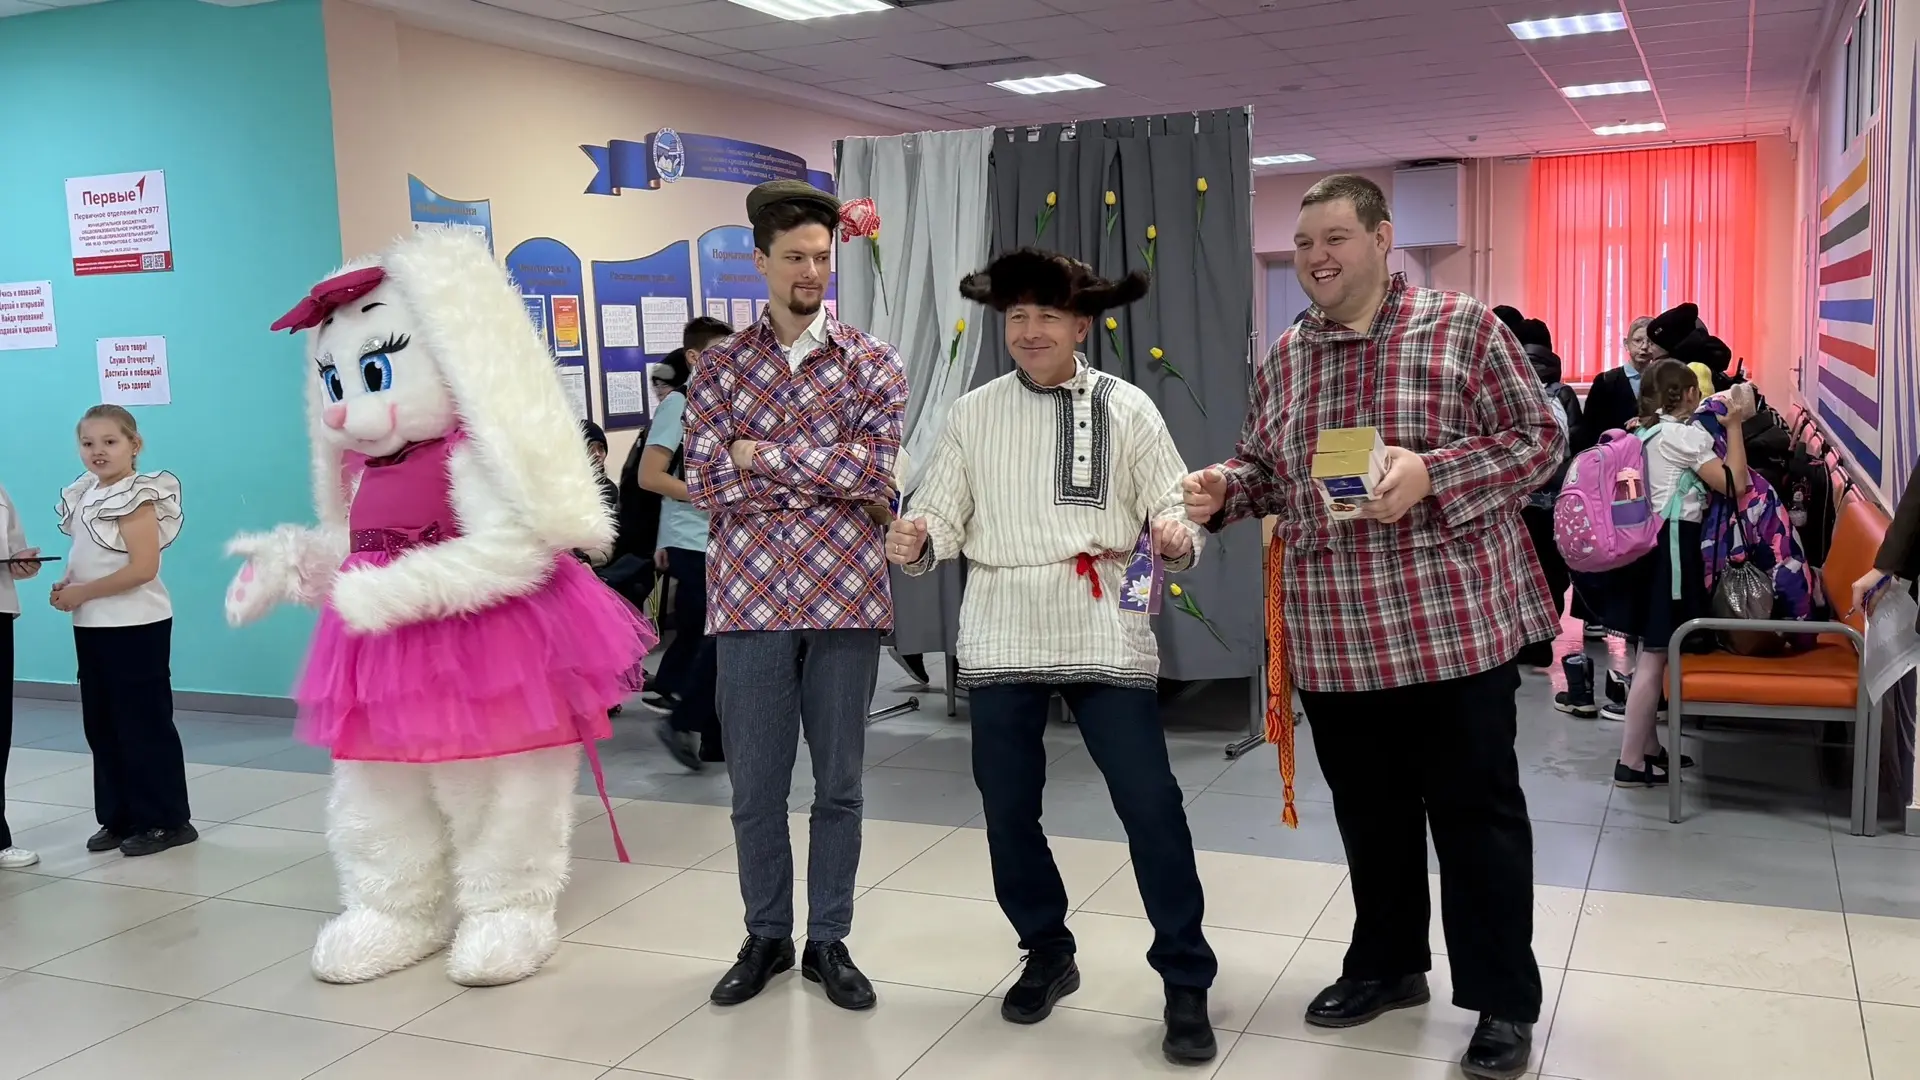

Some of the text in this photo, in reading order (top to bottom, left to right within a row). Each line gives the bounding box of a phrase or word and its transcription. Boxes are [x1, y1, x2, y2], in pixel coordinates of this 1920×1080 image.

[82, 190, 136, 207] Первые
[74, 212, 106, 220] Первичное
[107, 209, 138, 218] отделение
[114, 342, 147, 352] Благо твори!
[109, 354, 155, 366] Служи Отечеству!
[105, 368, 129, 379] Достигай
[134, 366, 162, 377] побеждай!
[117, 380, 151, 391] Будь здоров!
